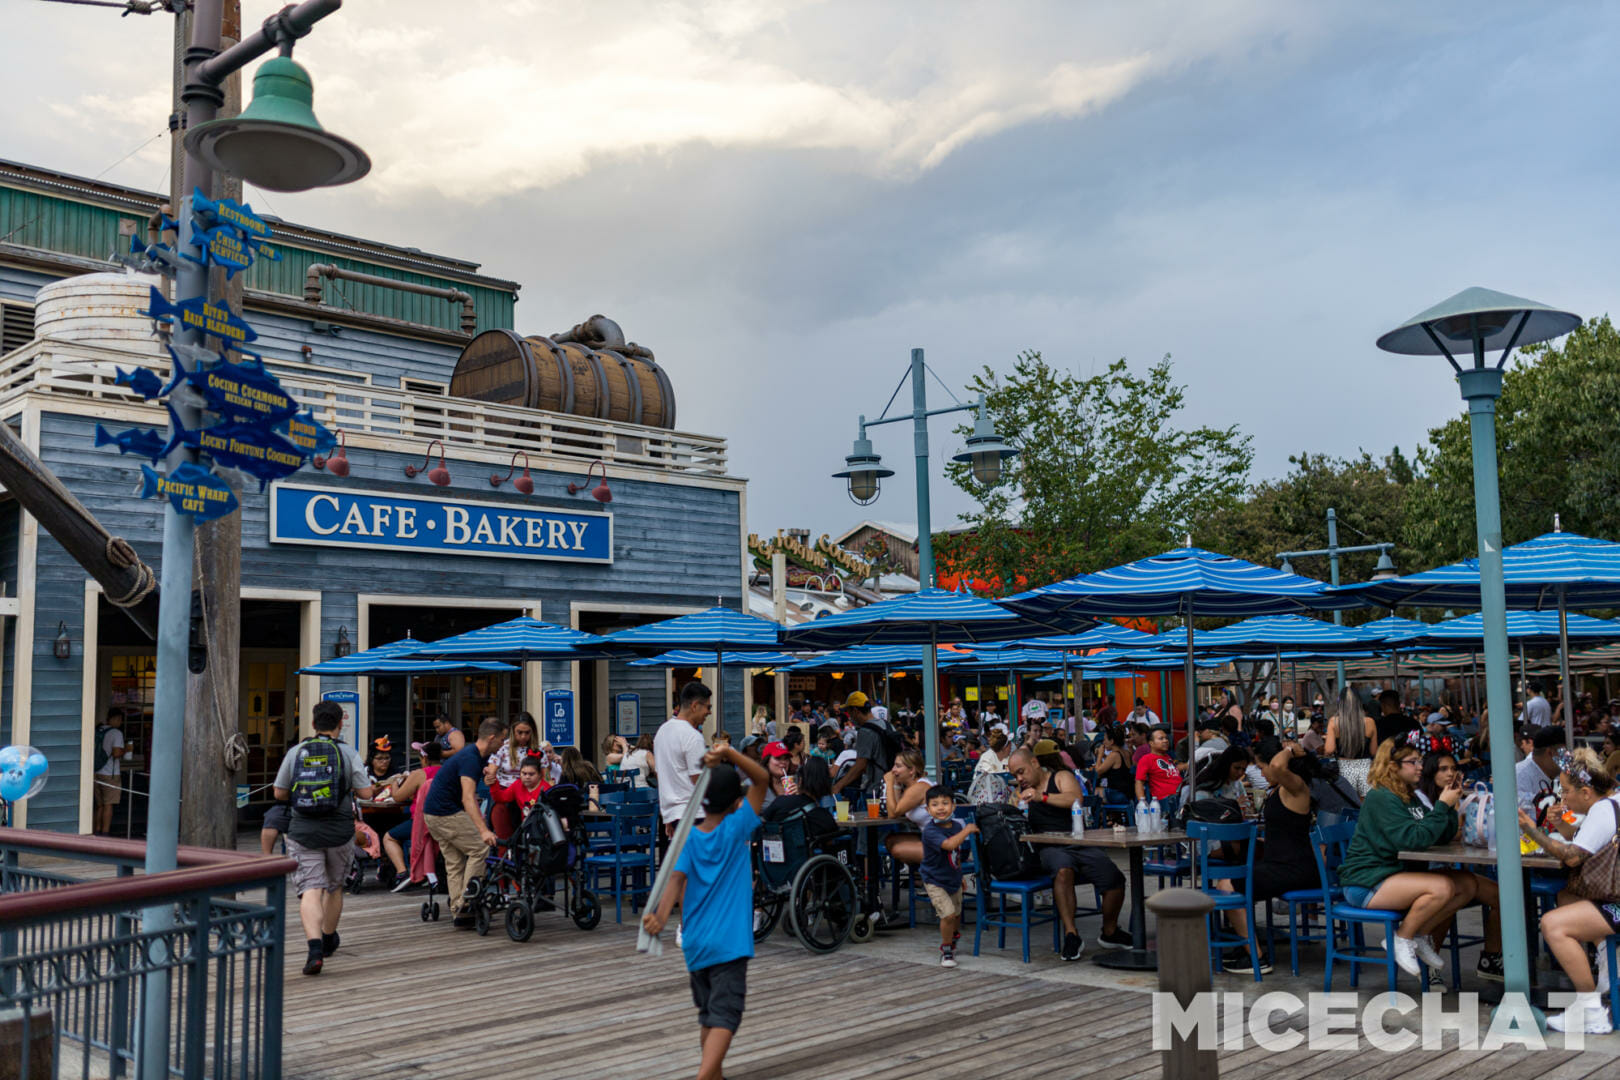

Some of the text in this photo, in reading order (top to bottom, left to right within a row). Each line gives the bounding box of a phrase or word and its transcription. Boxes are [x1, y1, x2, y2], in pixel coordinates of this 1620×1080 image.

[218, 203, 265, 234] RESTROOMS
[210, 240, 249, 266] SERVICES
[216, 231, 242, 251] CHILD
[259, 245, 275, 258] ATM
[203, 302, 228, 322] RITA'S
[184, 309, 246, 341] BAJA BLENDERS
[208, 374, 287, 408] COCINA CUCAMONGA
[225, 393, 253, 408] MEXICAN
[289, 419, 316, 435] BOUDIN
[200, 431, 301, 467] LUCKY FORTUNE COOKERY
[157, 478, 229, 502] PACIFIC WHARF
[182, 498, 205, 512] CAFE
[304, 494, 589, 551] CAFE BAKERY
[749, 528, 871, 578] UCK FORTUNE COOKERY
